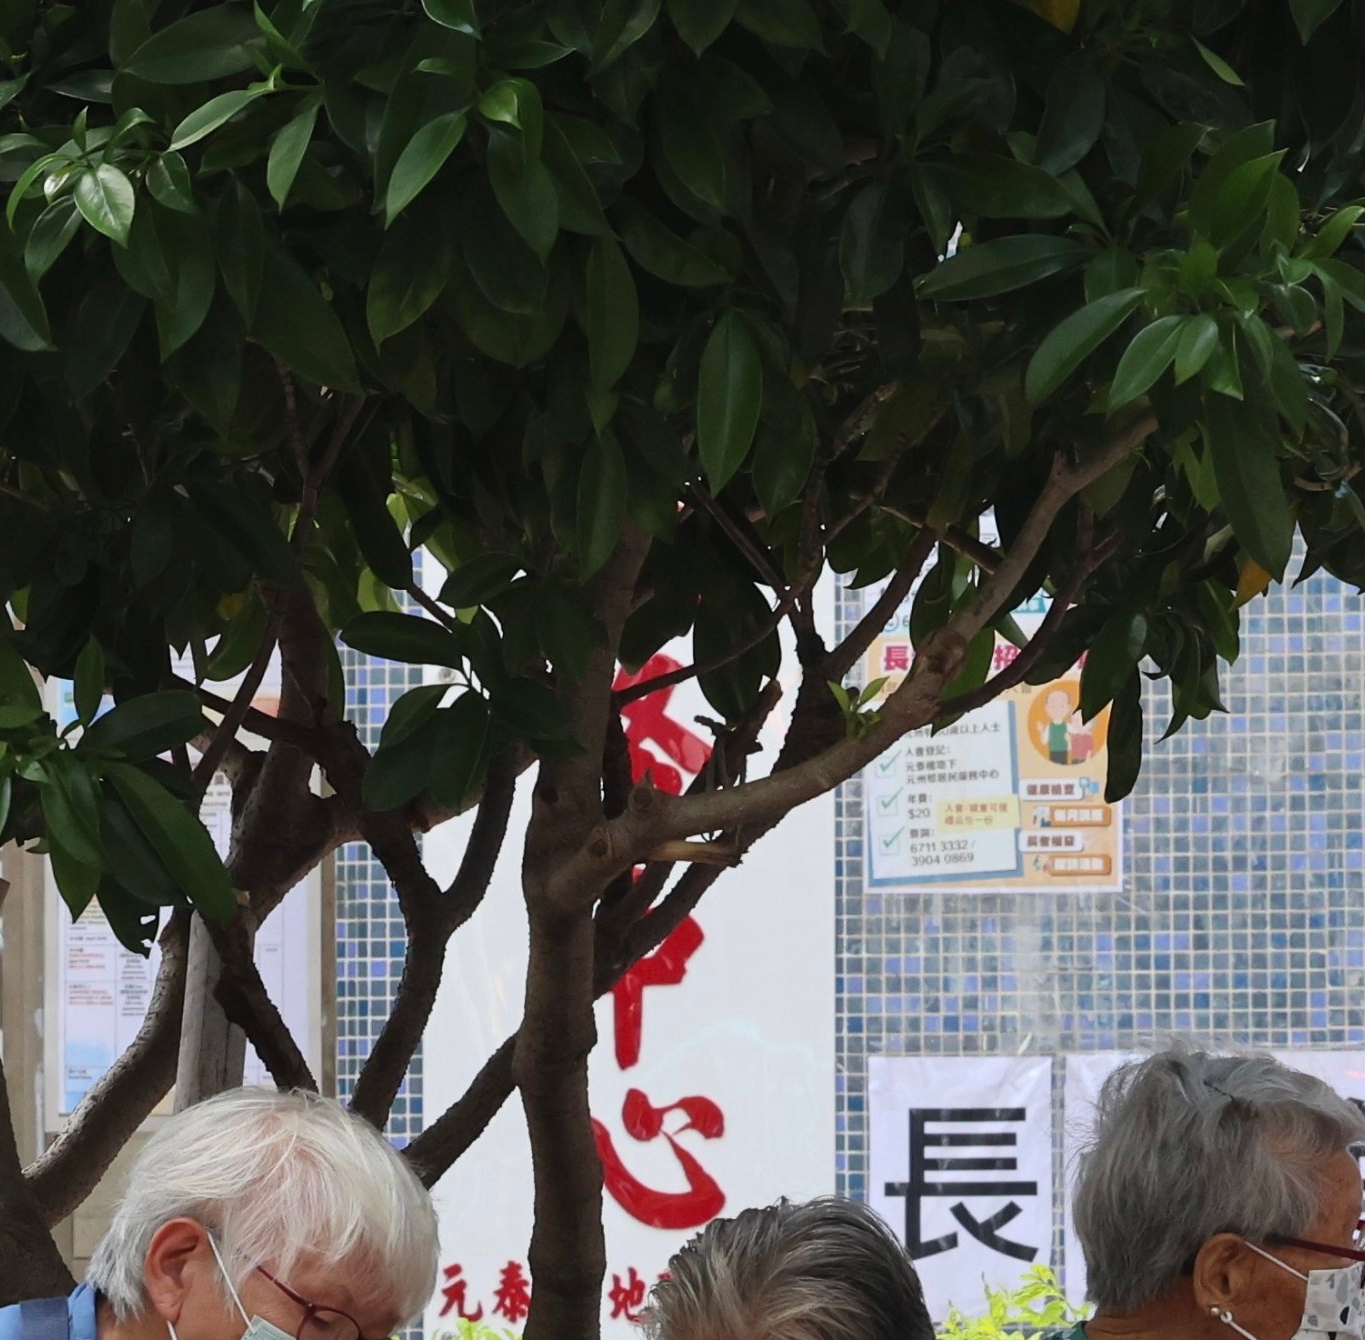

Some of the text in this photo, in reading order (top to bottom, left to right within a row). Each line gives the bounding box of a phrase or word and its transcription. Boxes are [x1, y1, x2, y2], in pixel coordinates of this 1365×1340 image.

[908, 808, 930, 820] $20
[910, 842, 936, 853] 6711
[940, 839, 968, 852] 3332
[911, 852, 974, 867] 3904 0869
